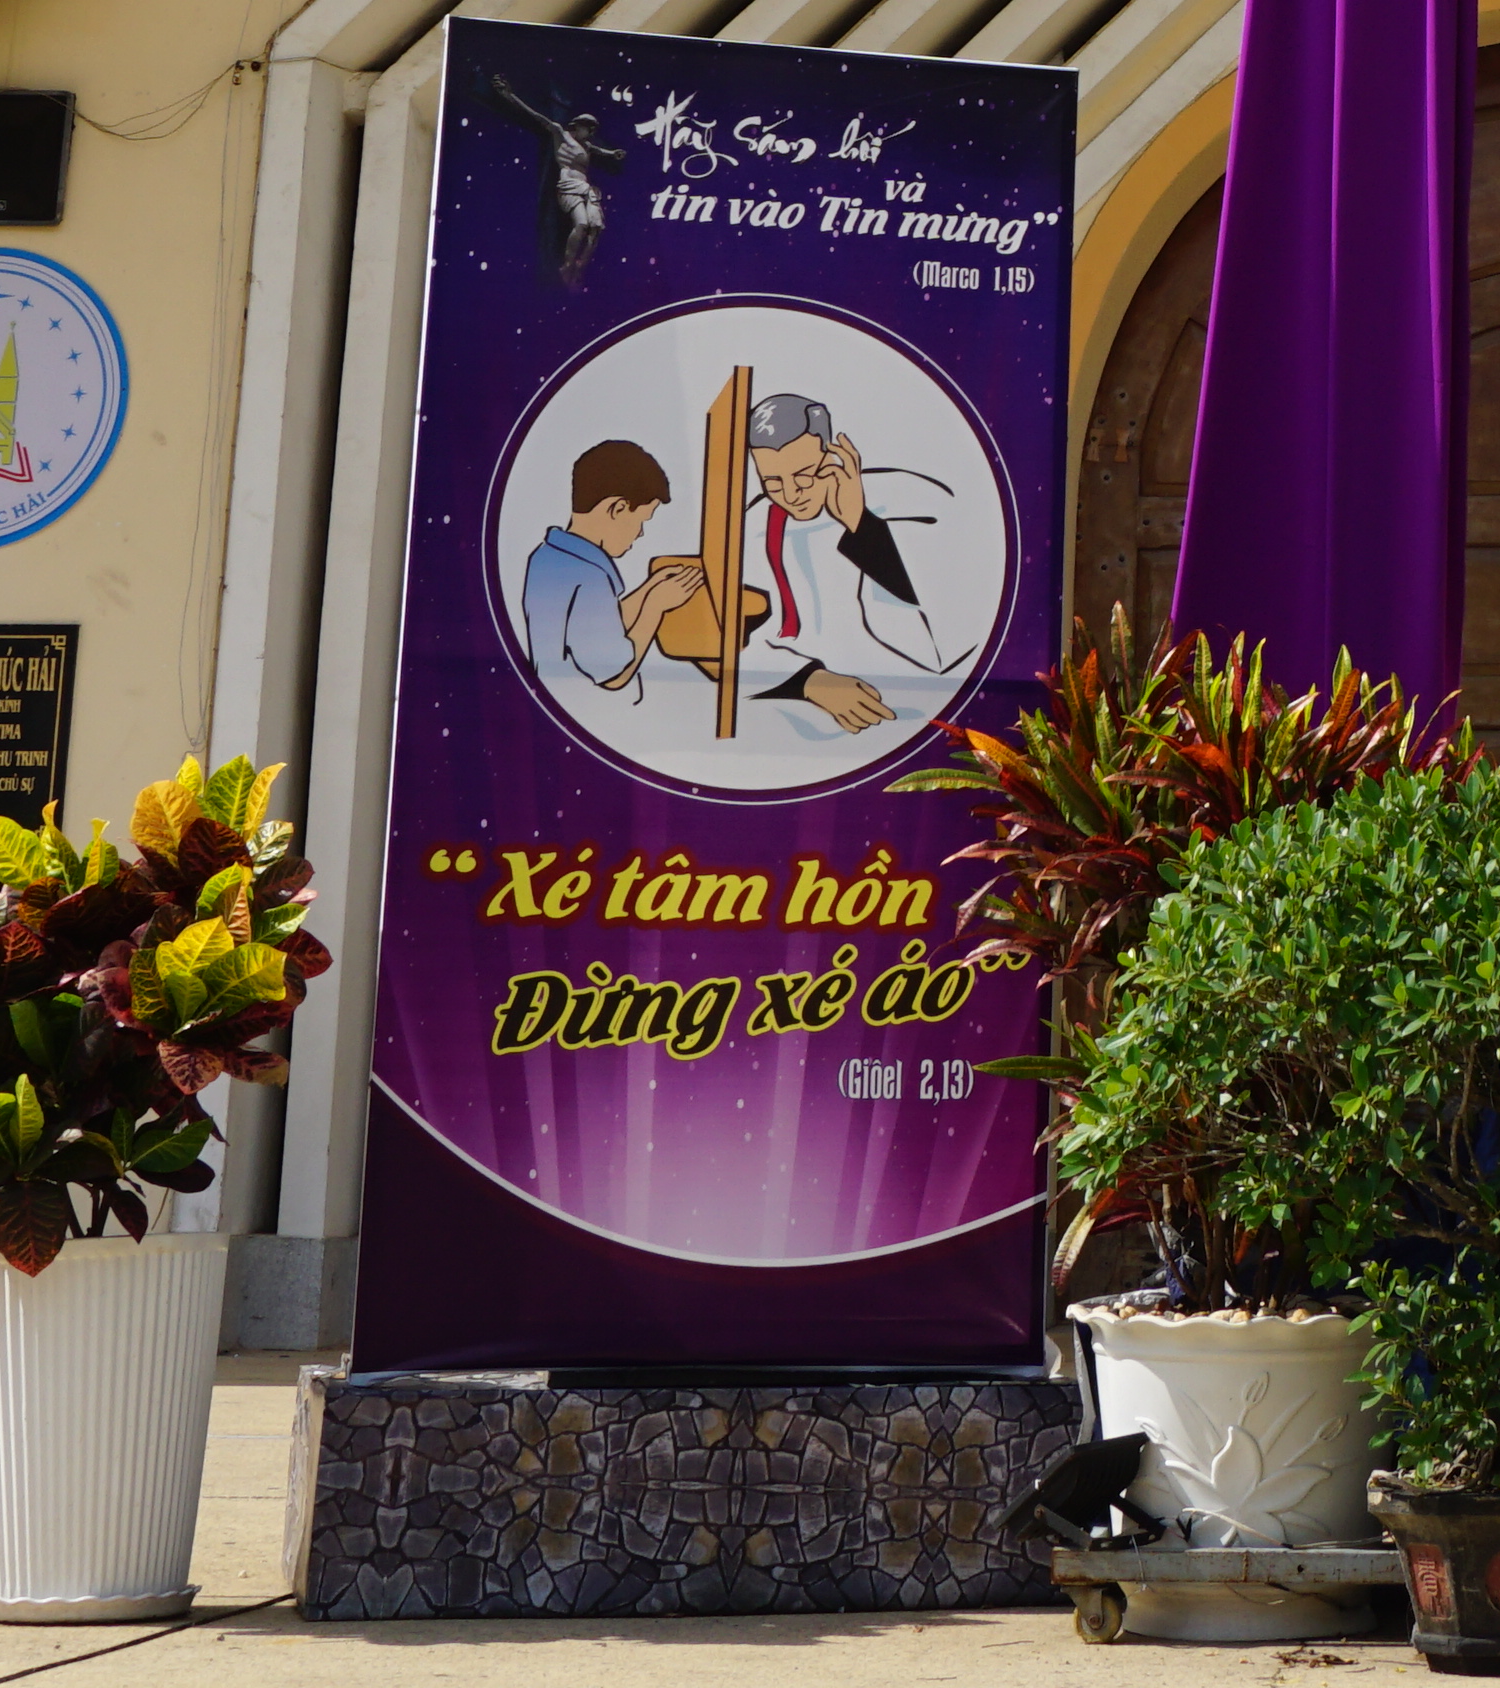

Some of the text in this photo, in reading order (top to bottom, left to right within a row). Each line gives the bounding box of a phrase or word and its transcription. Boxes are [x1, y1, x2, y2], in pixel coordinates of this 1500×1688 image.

[884, 171, 927, 203] và
[650, 184, 717, 223] tin
[727, 188, 806, 230] vào
[818, 195, 888, 236] Tin
[912, 260, 1036, 296] (Marco 1,15)
[11, 491, 47, 518] HẢI
[26, 645, 57, 692] HẢI
[15, 750, 49, 767] TRINH
[20, 776, 36, 795] SỰ
[605, 853, 768, 924] tâm
[784, 847, 934, 927] hồn
[492, 960, 741, 1061] Đừng
[746, 942, 858, 1036] xé
[838, 1058, 975, 1106] (Giôel 2,13)
